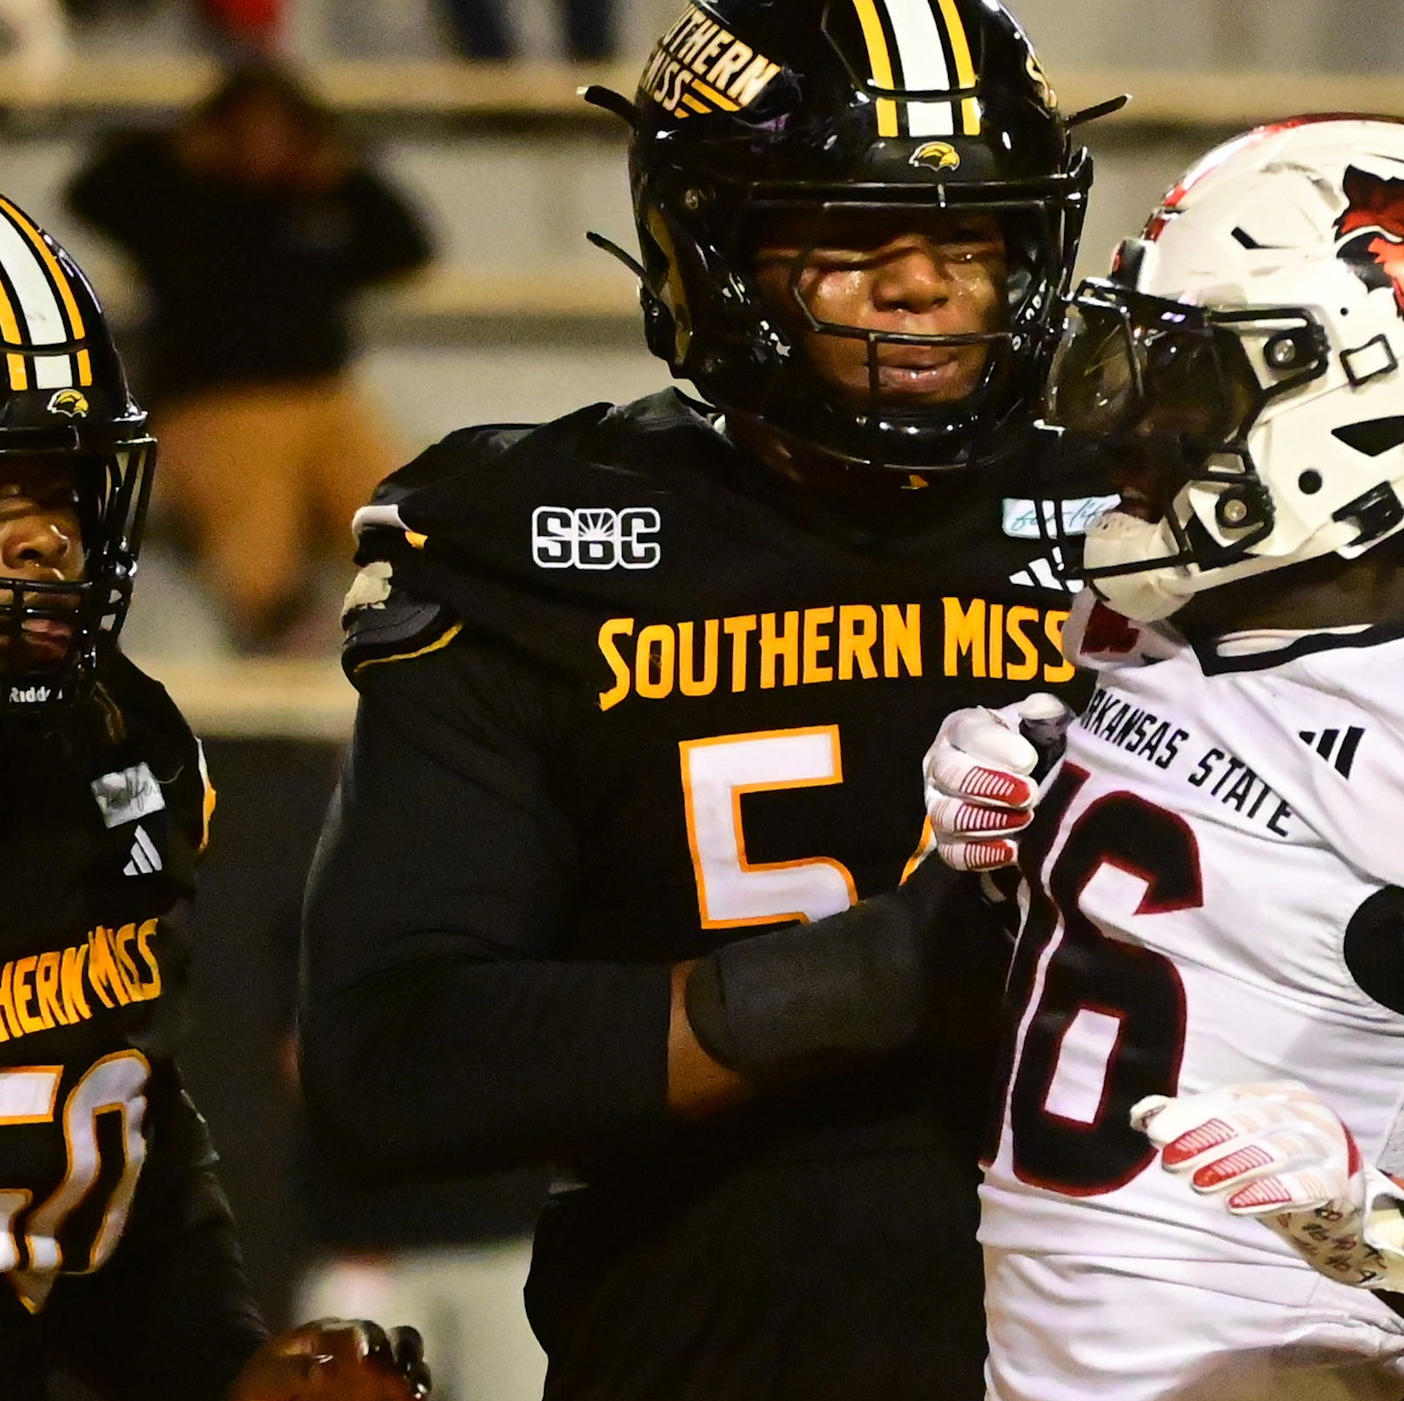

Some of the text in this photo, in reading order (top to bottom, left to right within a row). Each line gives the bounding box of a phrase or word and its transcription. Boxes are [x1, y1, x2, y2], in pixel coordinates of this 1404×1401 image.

[532, 506, 660, 569] SBC
[598, 596, 1077, 711] SOUTHERN MISS
[678, 724, 934, 930] 5
[1081, 688, 1299, 839] RKANSAS STATE
